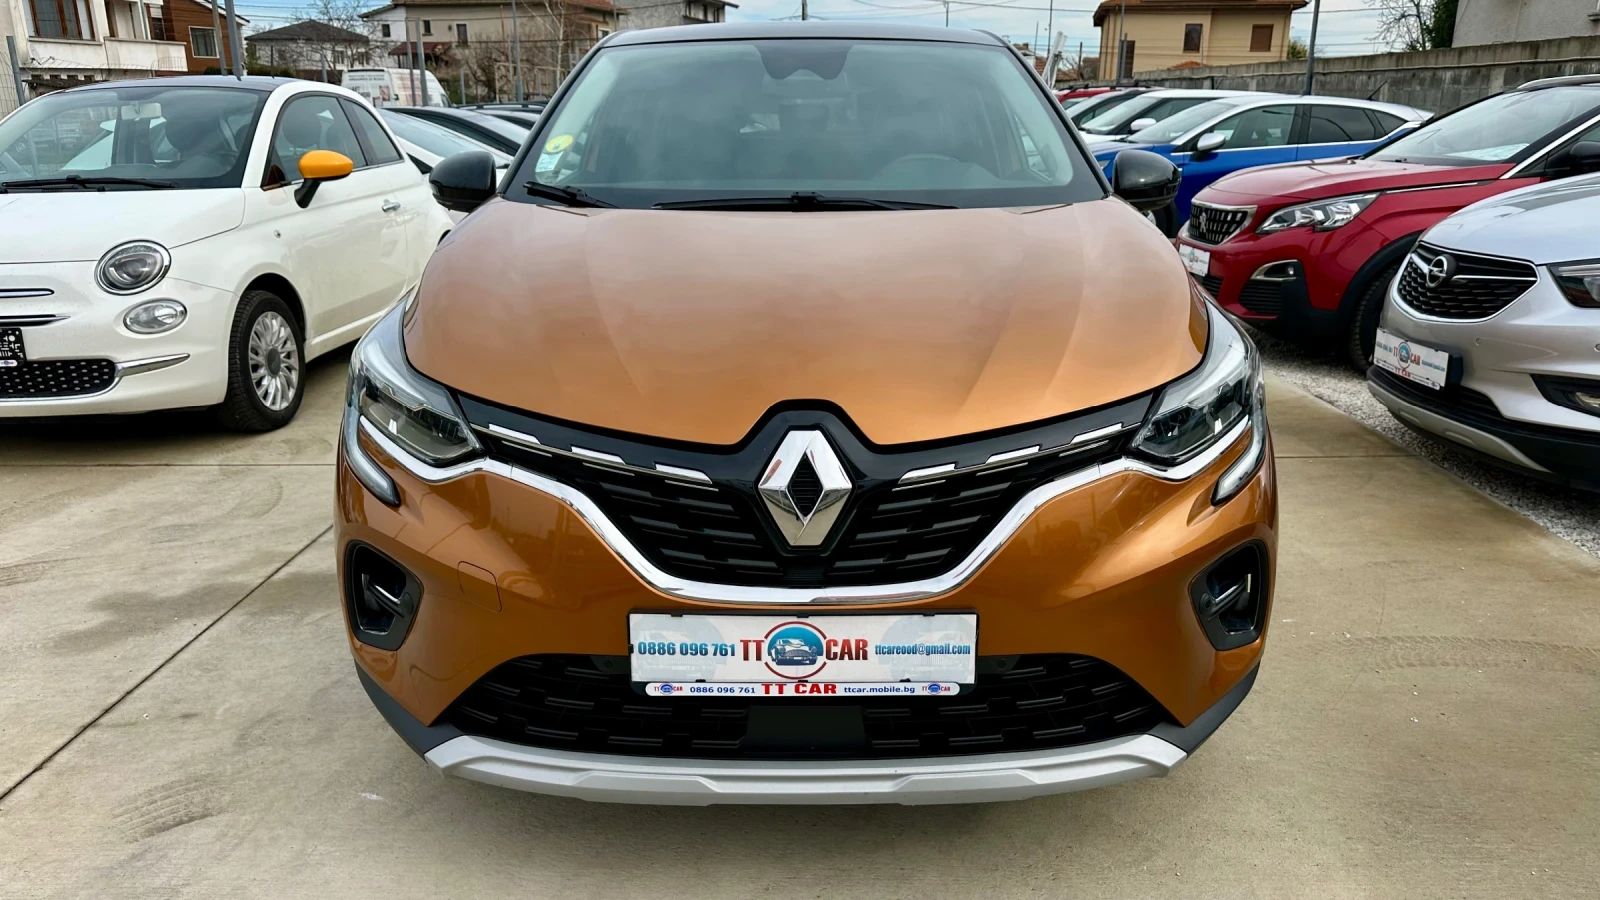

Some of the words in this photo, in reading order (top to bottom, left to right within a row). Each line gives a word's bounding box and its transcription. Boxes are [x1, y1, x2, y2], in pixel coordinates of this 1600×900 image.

[1394, 346, 1398, 358] TT
[1410, 353, 1421, 366] CAR
[637, 641, 676, 655] 0886
[679, 642, 709, 657] 096
[711, 643, 736, 657] 761
[740, 640, 765, 661] TT
[825, 638, 868, 661] CAR
[874, 643, 971, 656] ttcareood@gmail.com
[690, 686, 714, 694] 0886
[762, 684, 787, 694] TT
[794, 683, 837, 695] CAR
[843, 686, 916, 694] ttcar.mobile.bg
